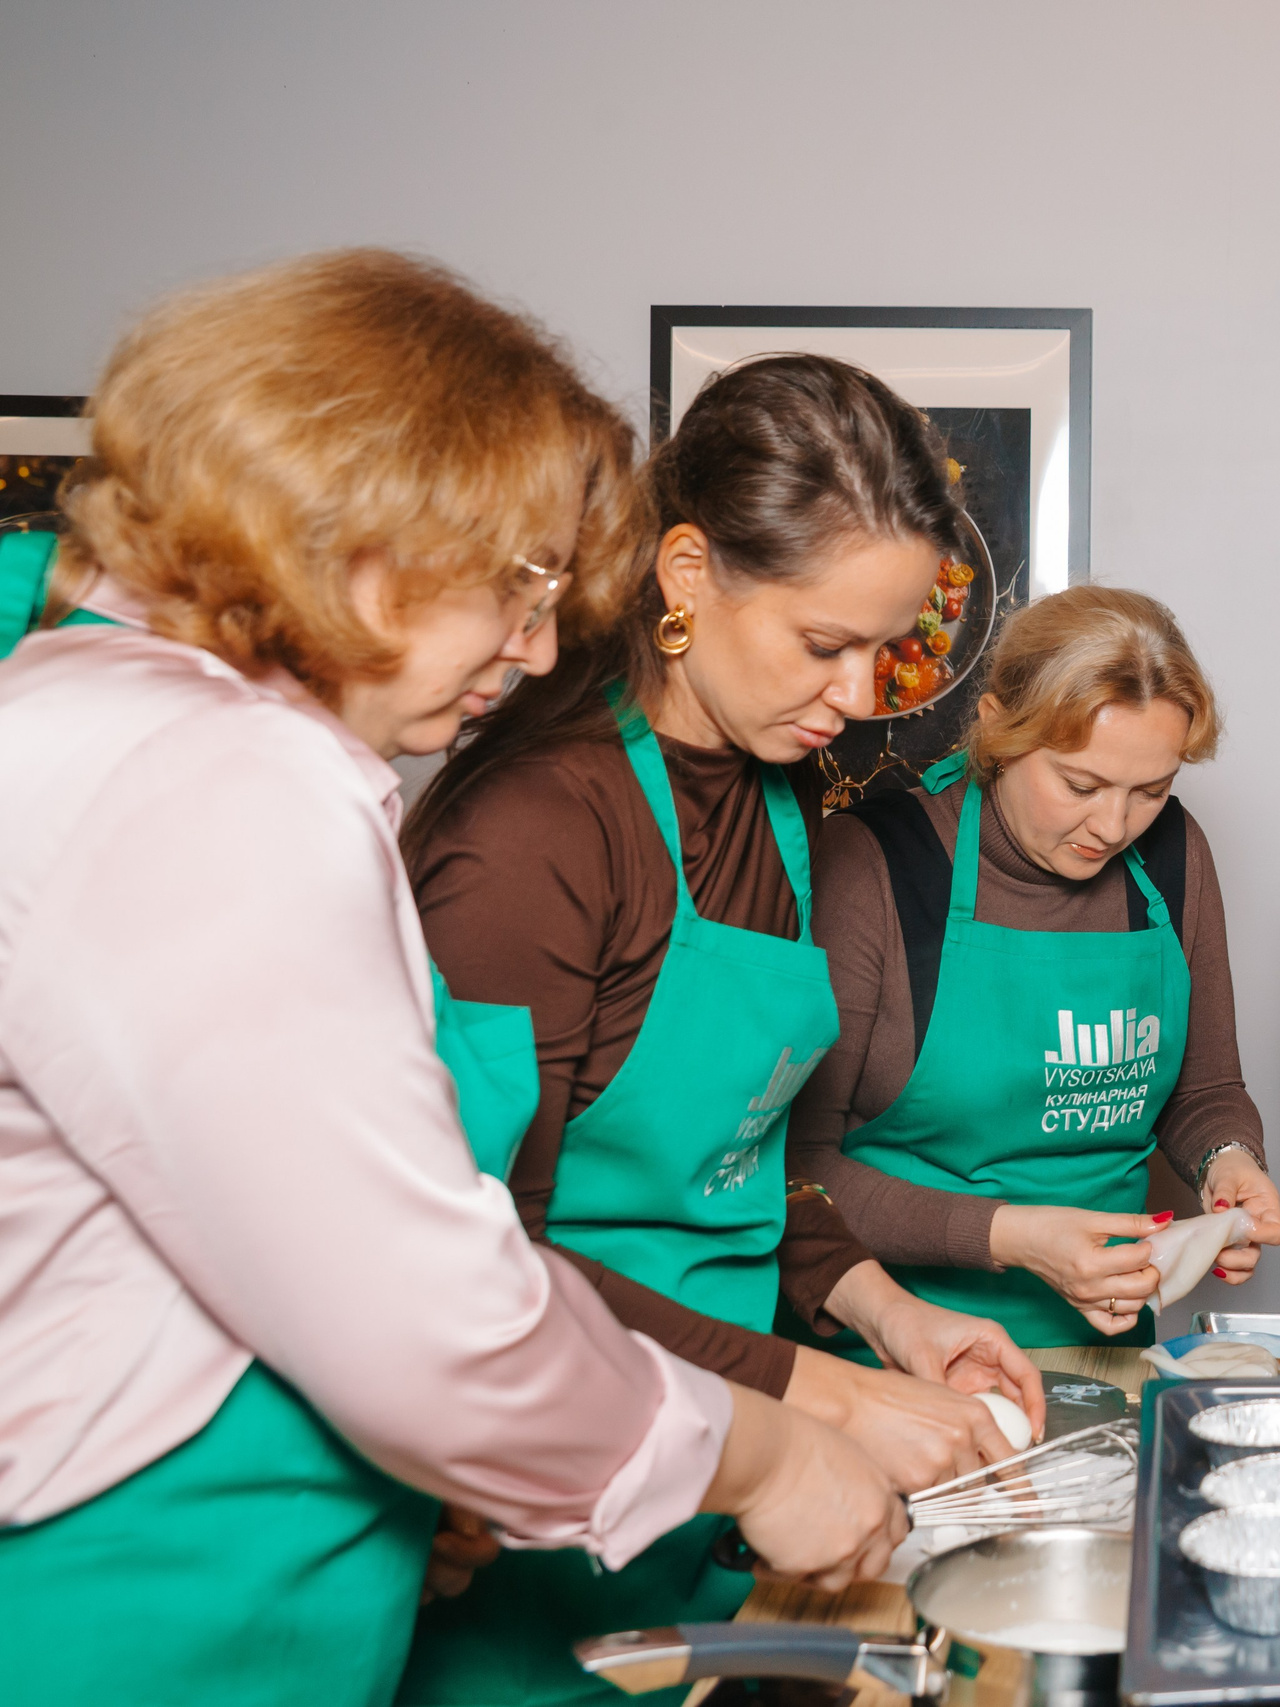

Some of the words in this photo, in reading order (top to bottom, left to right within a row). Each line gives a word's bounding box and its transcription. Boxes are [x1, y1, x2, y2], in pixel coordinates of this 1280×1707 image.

[1044, 1007, 1161, 1067] Julia
[1044, 1056, 1156, 1088] VYSOTSKAYA
[1045, 1084, 1149, 1107] КУЛИНАРНАЯ
[1041, 1100, 1145, 1133] СТУДИЯ
